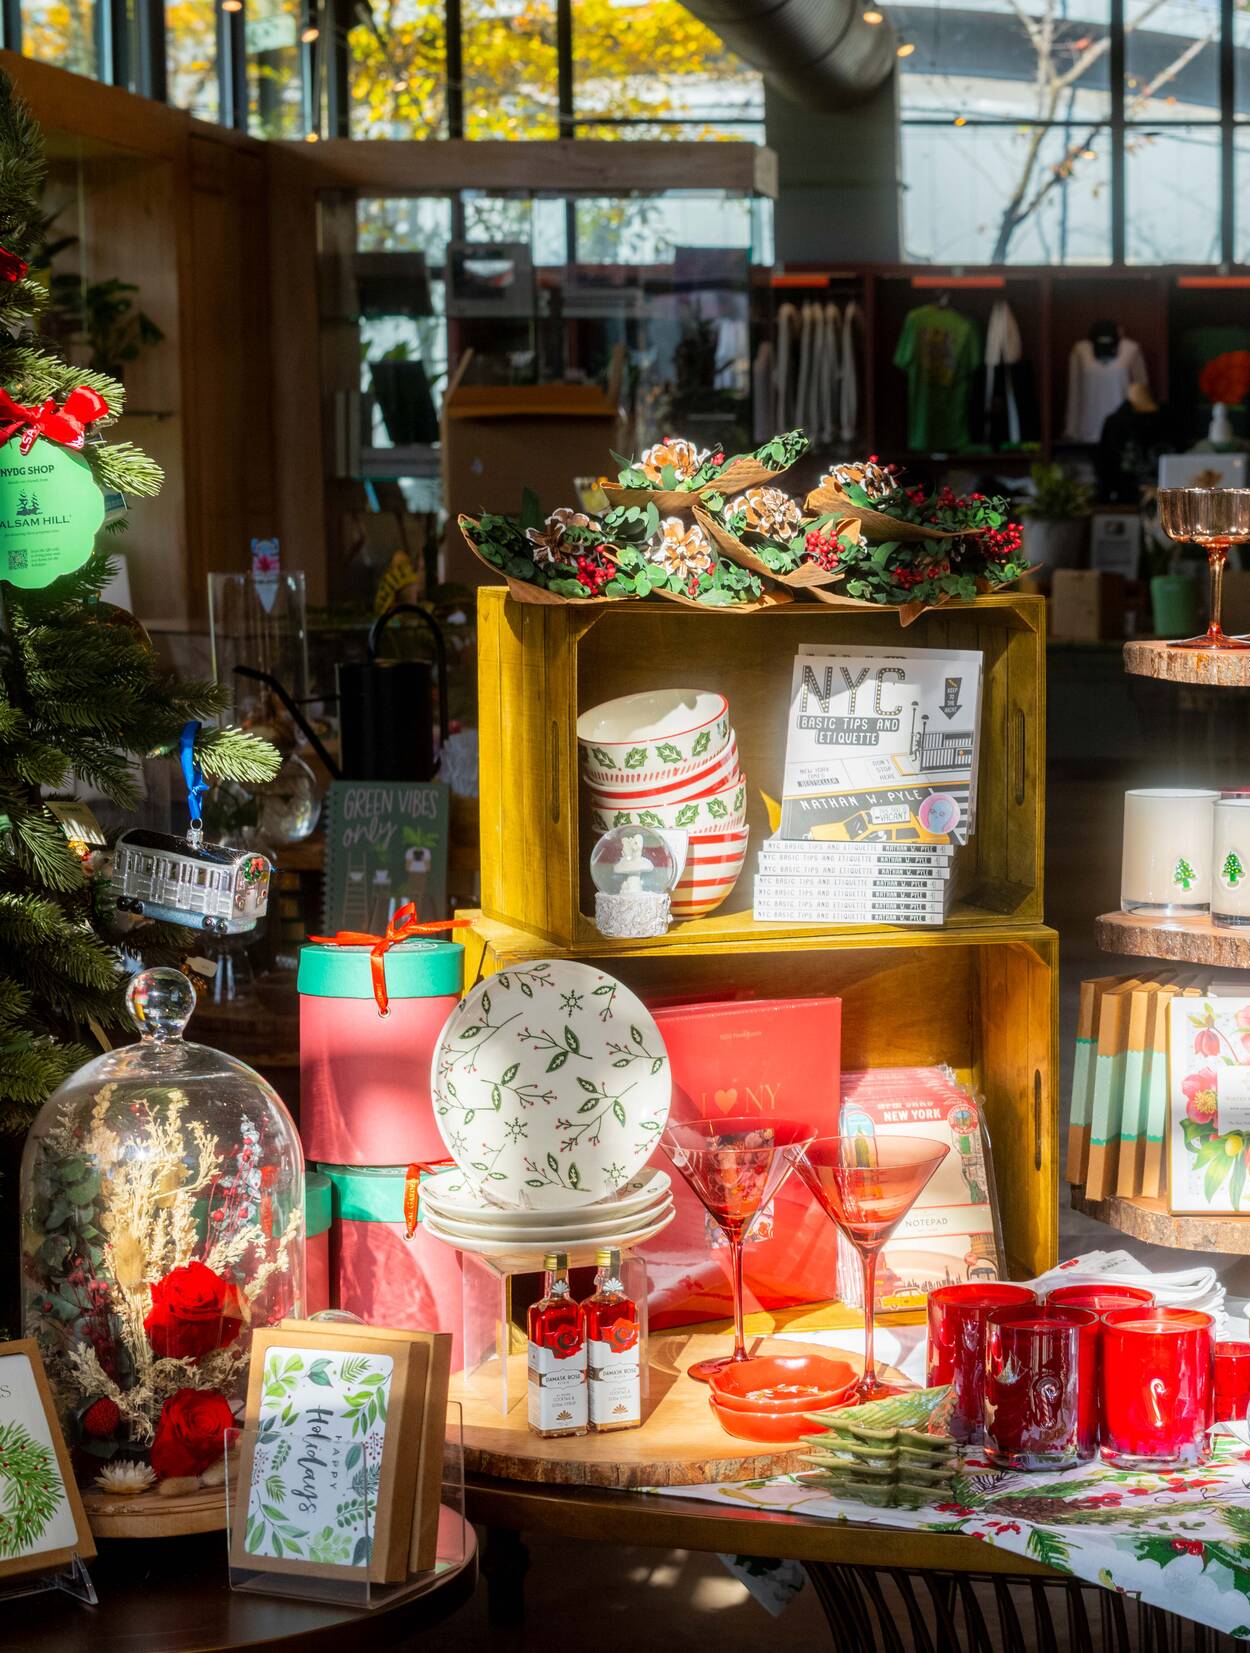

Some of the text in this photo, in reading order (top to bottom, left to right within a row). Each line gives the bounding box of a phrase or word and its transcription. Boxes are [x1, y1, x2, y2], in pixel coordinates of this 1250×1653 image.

[28, 465, 55, 475] SHOP
[0, 515, 70, 529] ALSAM HILL
[800, 665, 906, 716] NYC
[801, 717, 899, 732] BASIC TIPS AND
[818, 731, 878, 745] ETIQUETTE
[343, 788, 439, 821] GREEN VIBES
[800, 789, 923, 811] NATHAN W. PYLE
[342, 817, 398, 849] only
[745, 1082, 781, 1113] NY
[884, 1110, 910, 1122] NEW
[911, 1108, 941, 1121] YORK
[905, 1217, 949, 1228] NOTEPAD
[545, 1375, 567, 1383] DAMASK
[291, 1405, 334, 1514] Holidays
[329, 1435, 342, 1490] HAPPY
